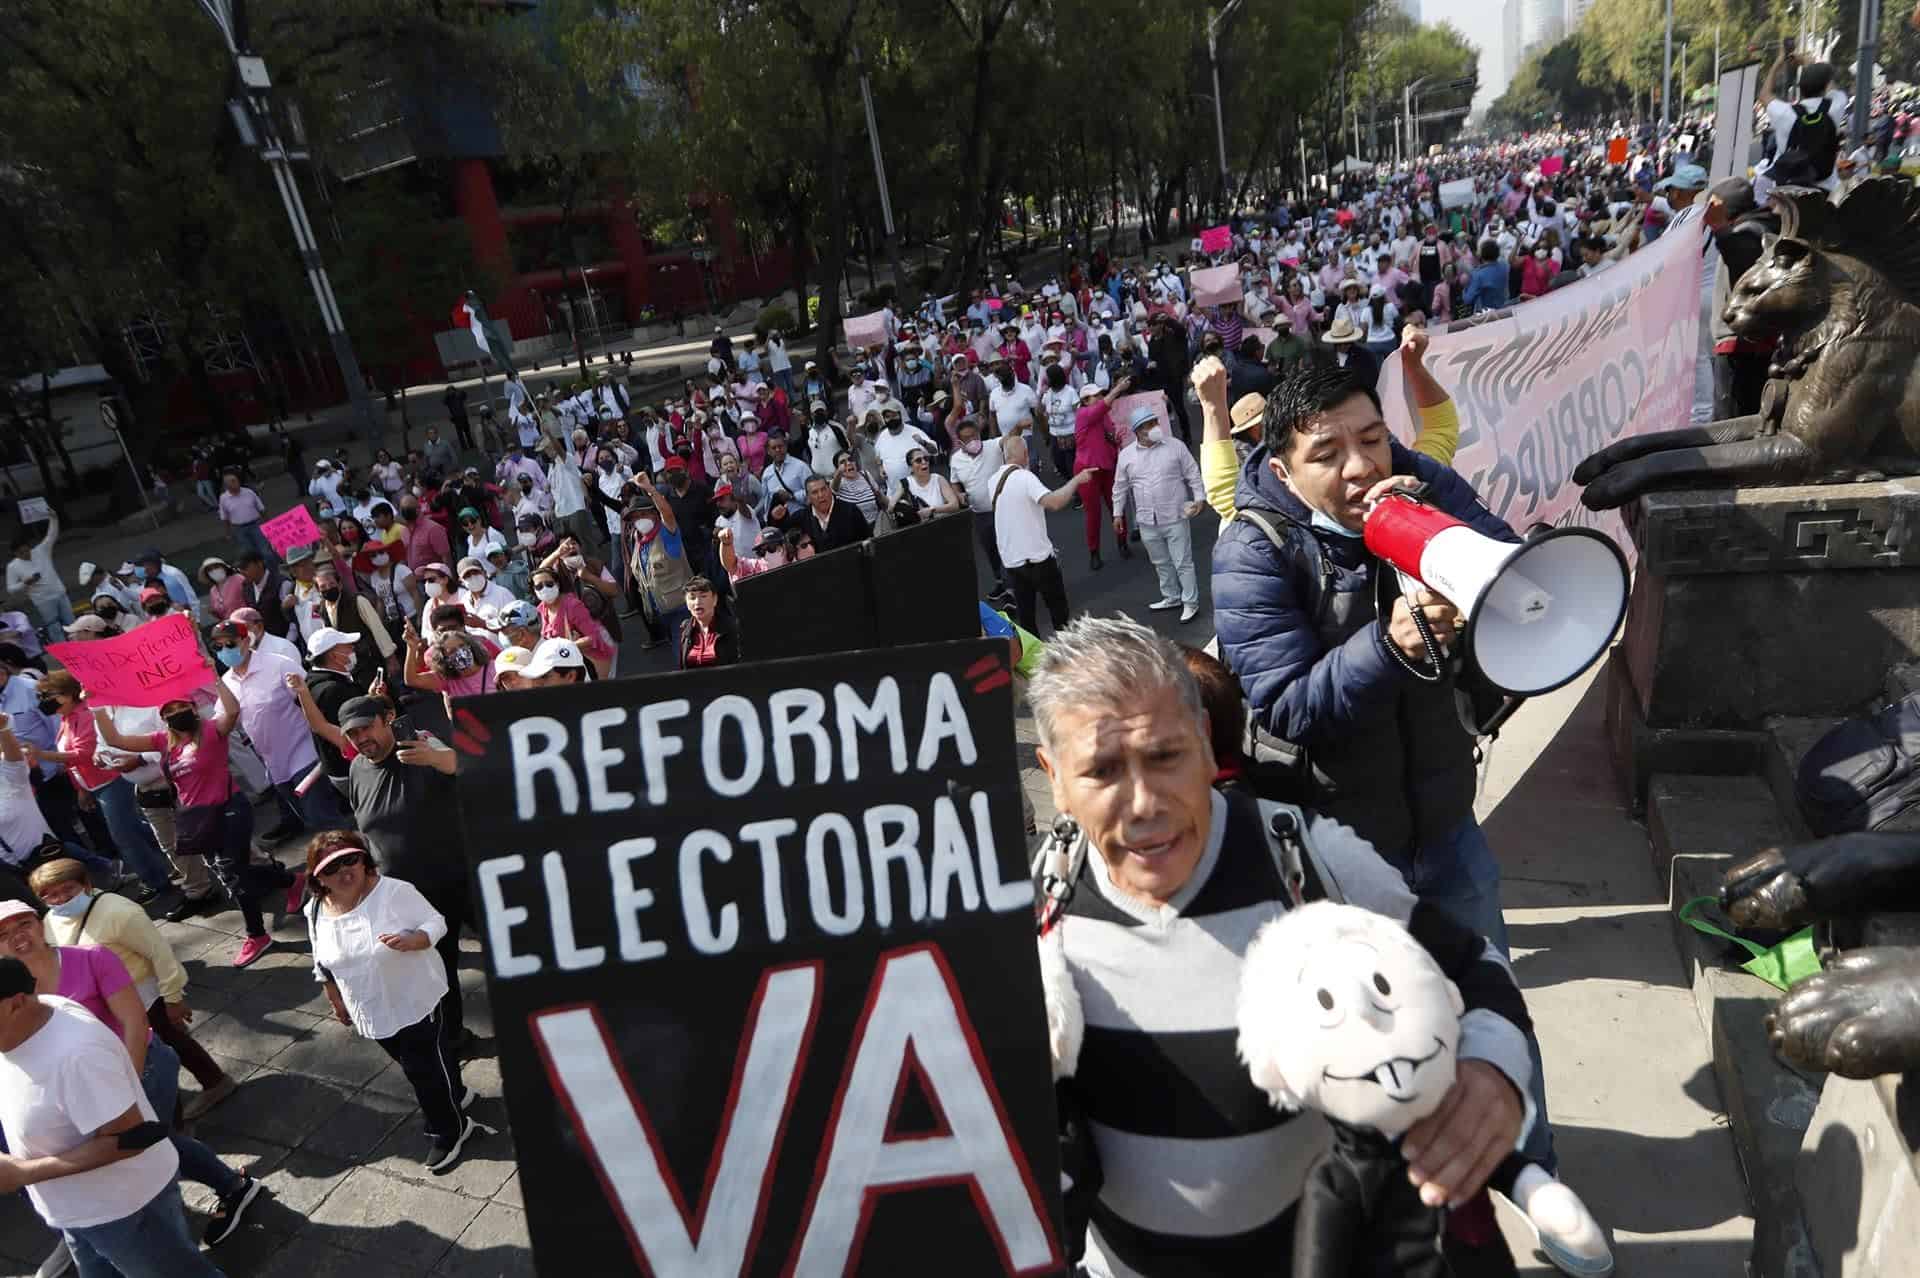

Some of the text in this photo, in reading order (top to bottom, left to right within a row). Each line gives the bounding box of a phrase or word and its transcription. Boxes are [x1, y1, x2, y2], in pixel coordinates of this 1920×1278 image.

[136, 655, 182, 688] INE
[508, 671, 978, 821] REFORMA
[477, 791, 1035, 979] ELECTORAL
[528, 941, 1065, 1278] VA
